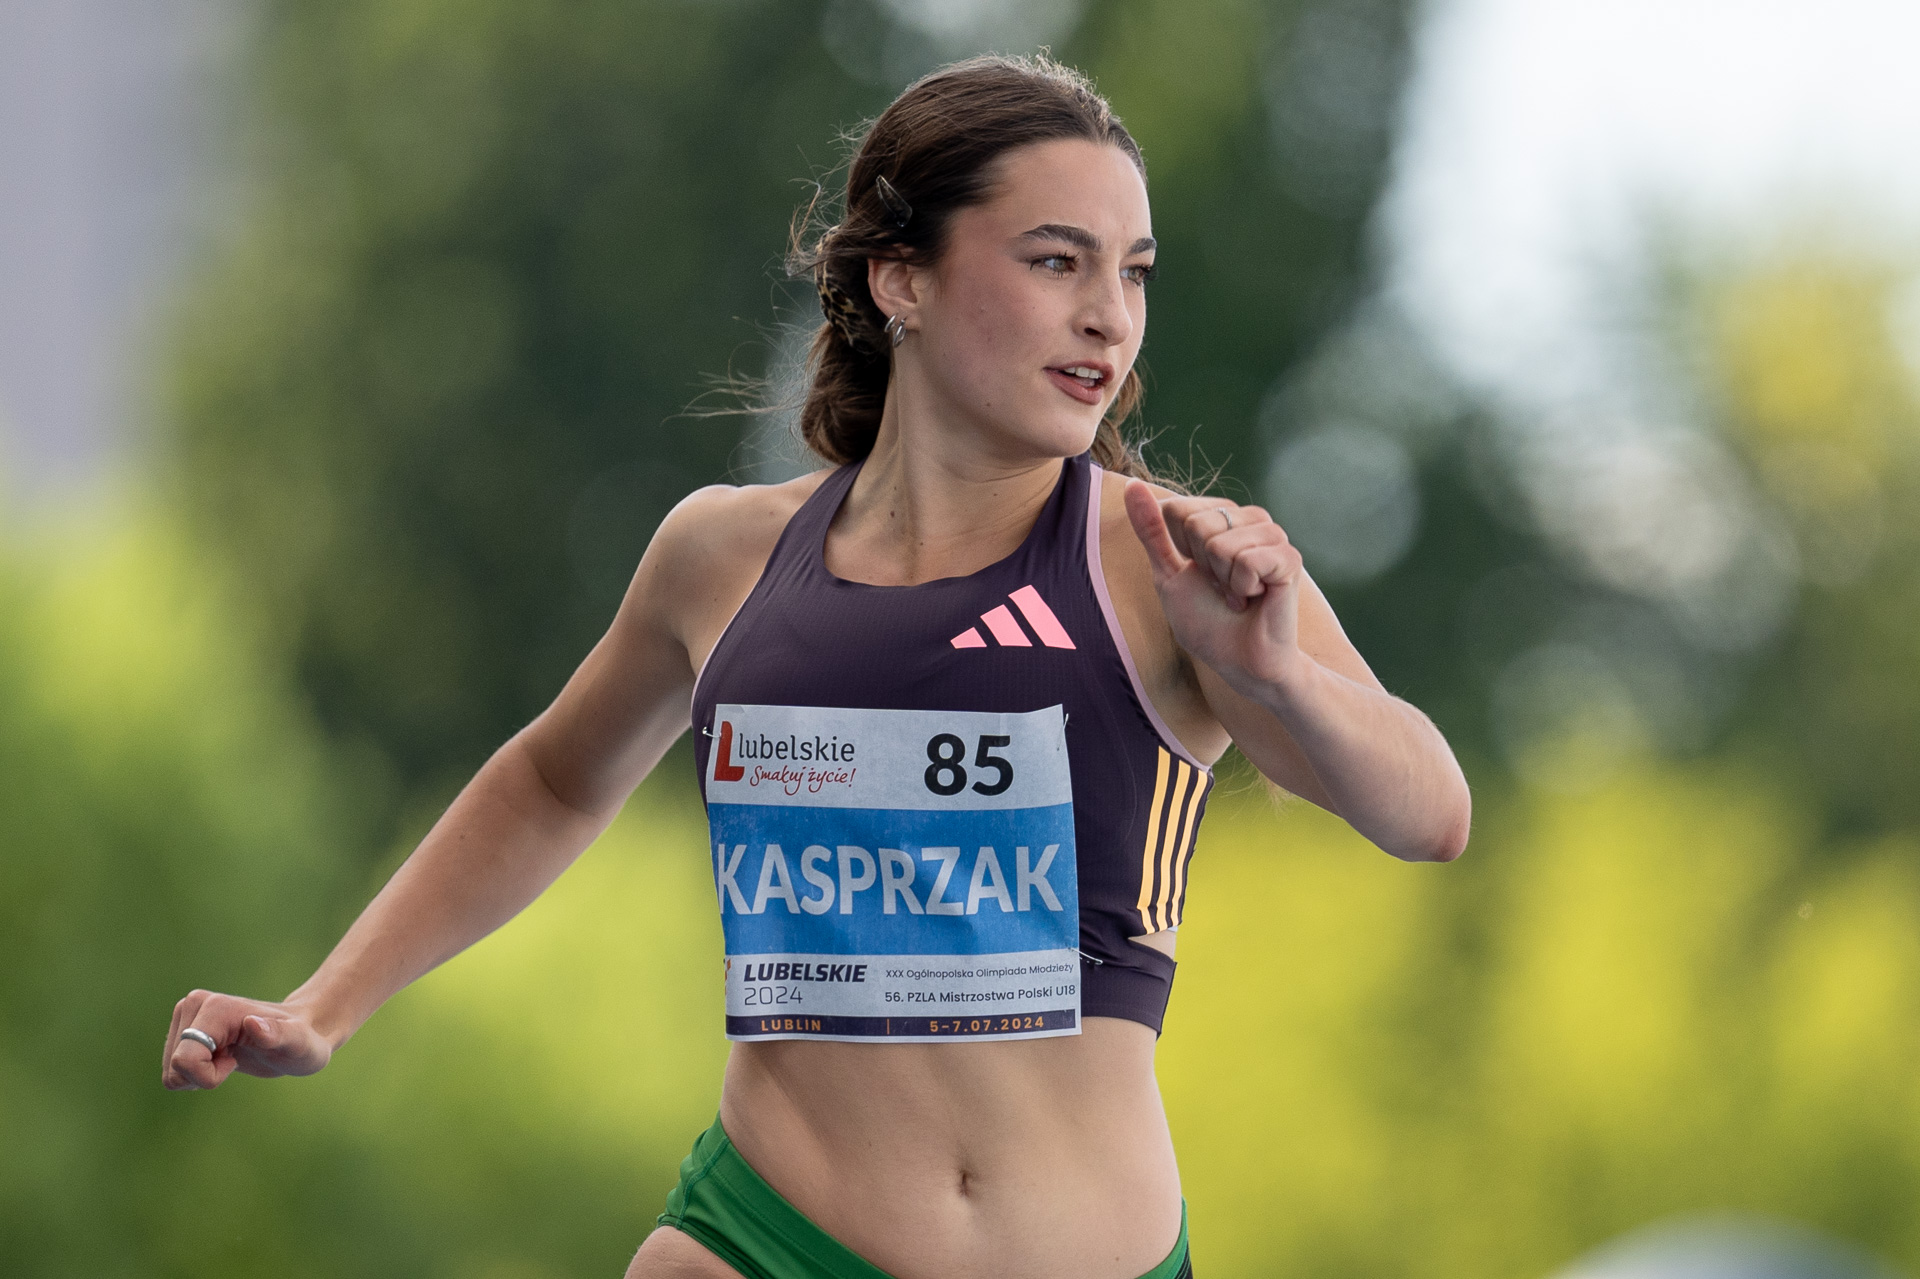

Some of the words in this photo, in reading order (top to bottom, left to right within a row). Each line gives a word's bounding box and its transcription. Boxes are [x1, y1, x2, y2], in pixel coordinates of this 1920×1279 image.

[739, 733, 855, 762] lubelskie
[924, 733, 1014, 796] 85
[750, 765, 807, 796] Smakuj
[808, 767, 857, 794] życie!
[718, 843, 1064, 915] KASPRZAK
[744, 963, 868, 982] LUBELSKIE
[886, 969, 904, 978] XXX
[906, 968, 974, 980] Ogólnopolska
[976, 966, 1027, 979] Olimpiada
[1029, 963, 1074, 974] Młodzieży
[744, 986, 803, 1006] 2024
[885, 991, 904, 1003] 56.
[907, 992, 936, 1003] PZLA
[939, 990, 1015, 1003] Mistrzostwa
[1018, 986, 1053, 1000] Polski
[1056, 984, 1076, 996] U18
[761, 1019, 822, 1032] LUBLIN
[929, 1016, 1044, 1033] 5-7.07.2024
